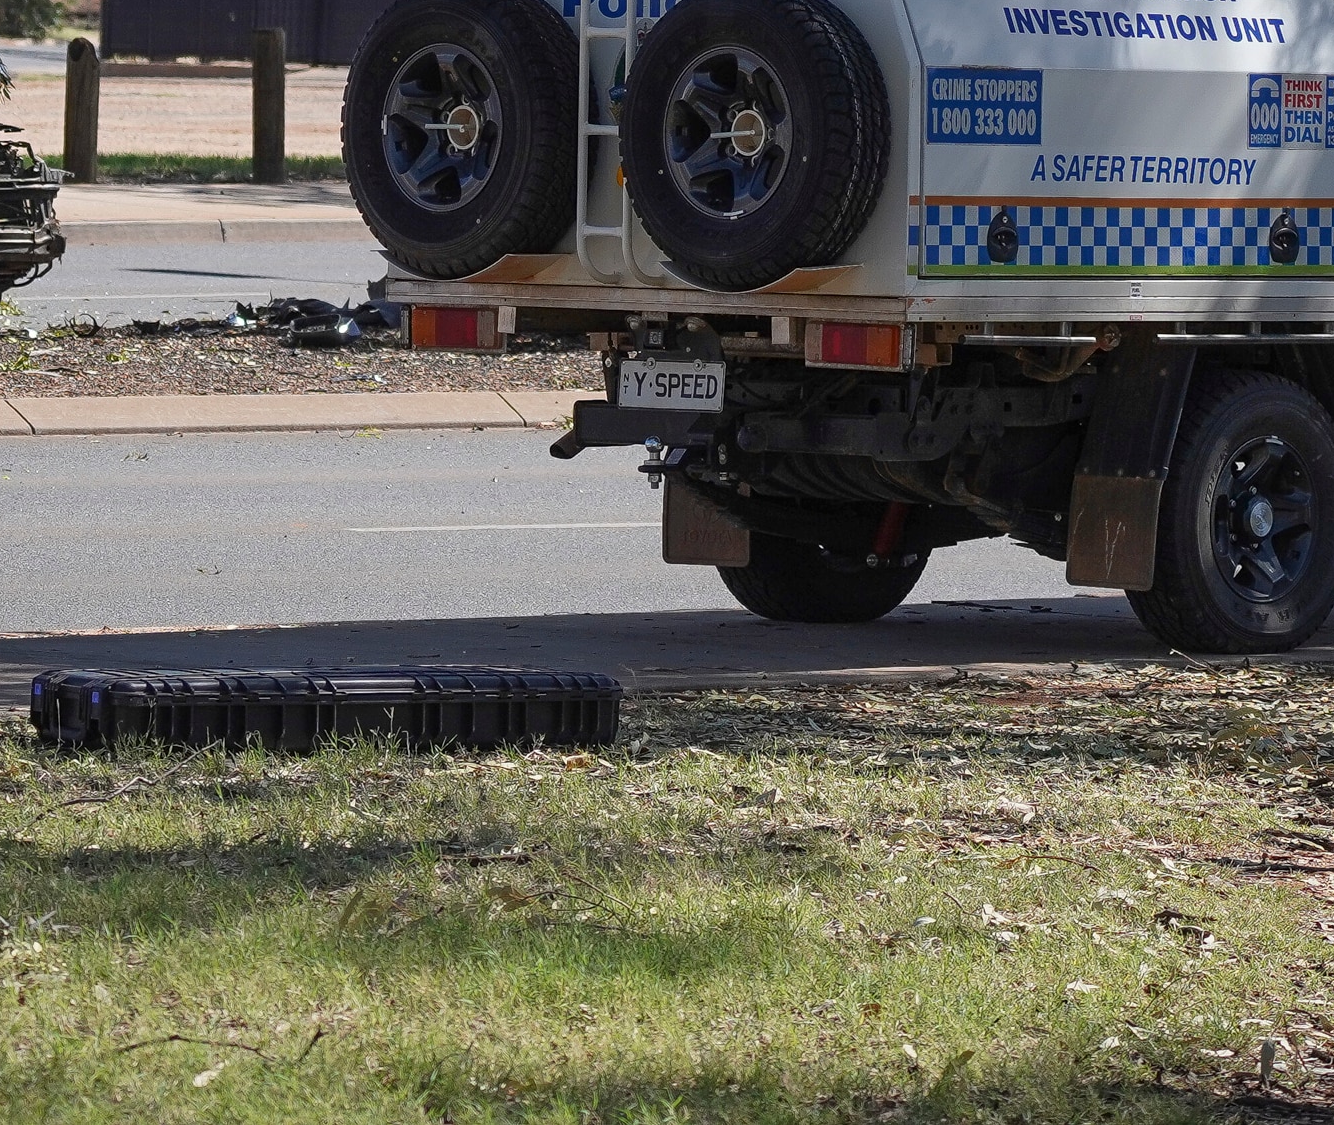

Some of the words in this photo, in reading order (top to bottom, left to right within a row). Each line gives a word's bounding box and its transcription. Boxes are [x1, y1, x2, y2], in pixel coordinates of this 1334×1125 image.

[1003, 7, 1218, 42] INVESTIGATION
[1221, 16, 1286, 44] UNIT
[932, 78, 972, 101] CRIME
[974, 79, 1038, 103] STOPPERS
[1285, 79, 1323, 92] THINK
[1284, 93, 1323, 109] FIRST
[932, 107, 938, 134] 1
[941, 107, 972, 135] 800
[974, 107, 1004, 135] 333
[1008, 108, 1037, 136] 000
[1250, 102, 1280, 130] 000
[1284, 110, 1323, 125] THEN
[1250, 134, 1279, 144] EMERGENCY
[1284, 126, 1323, 143] DIAL
[1030, 154, 1046, 181] A
[1051, 154, 1125, 183] SAFER
[1130, 156, 1257, 185] TERRITORY
